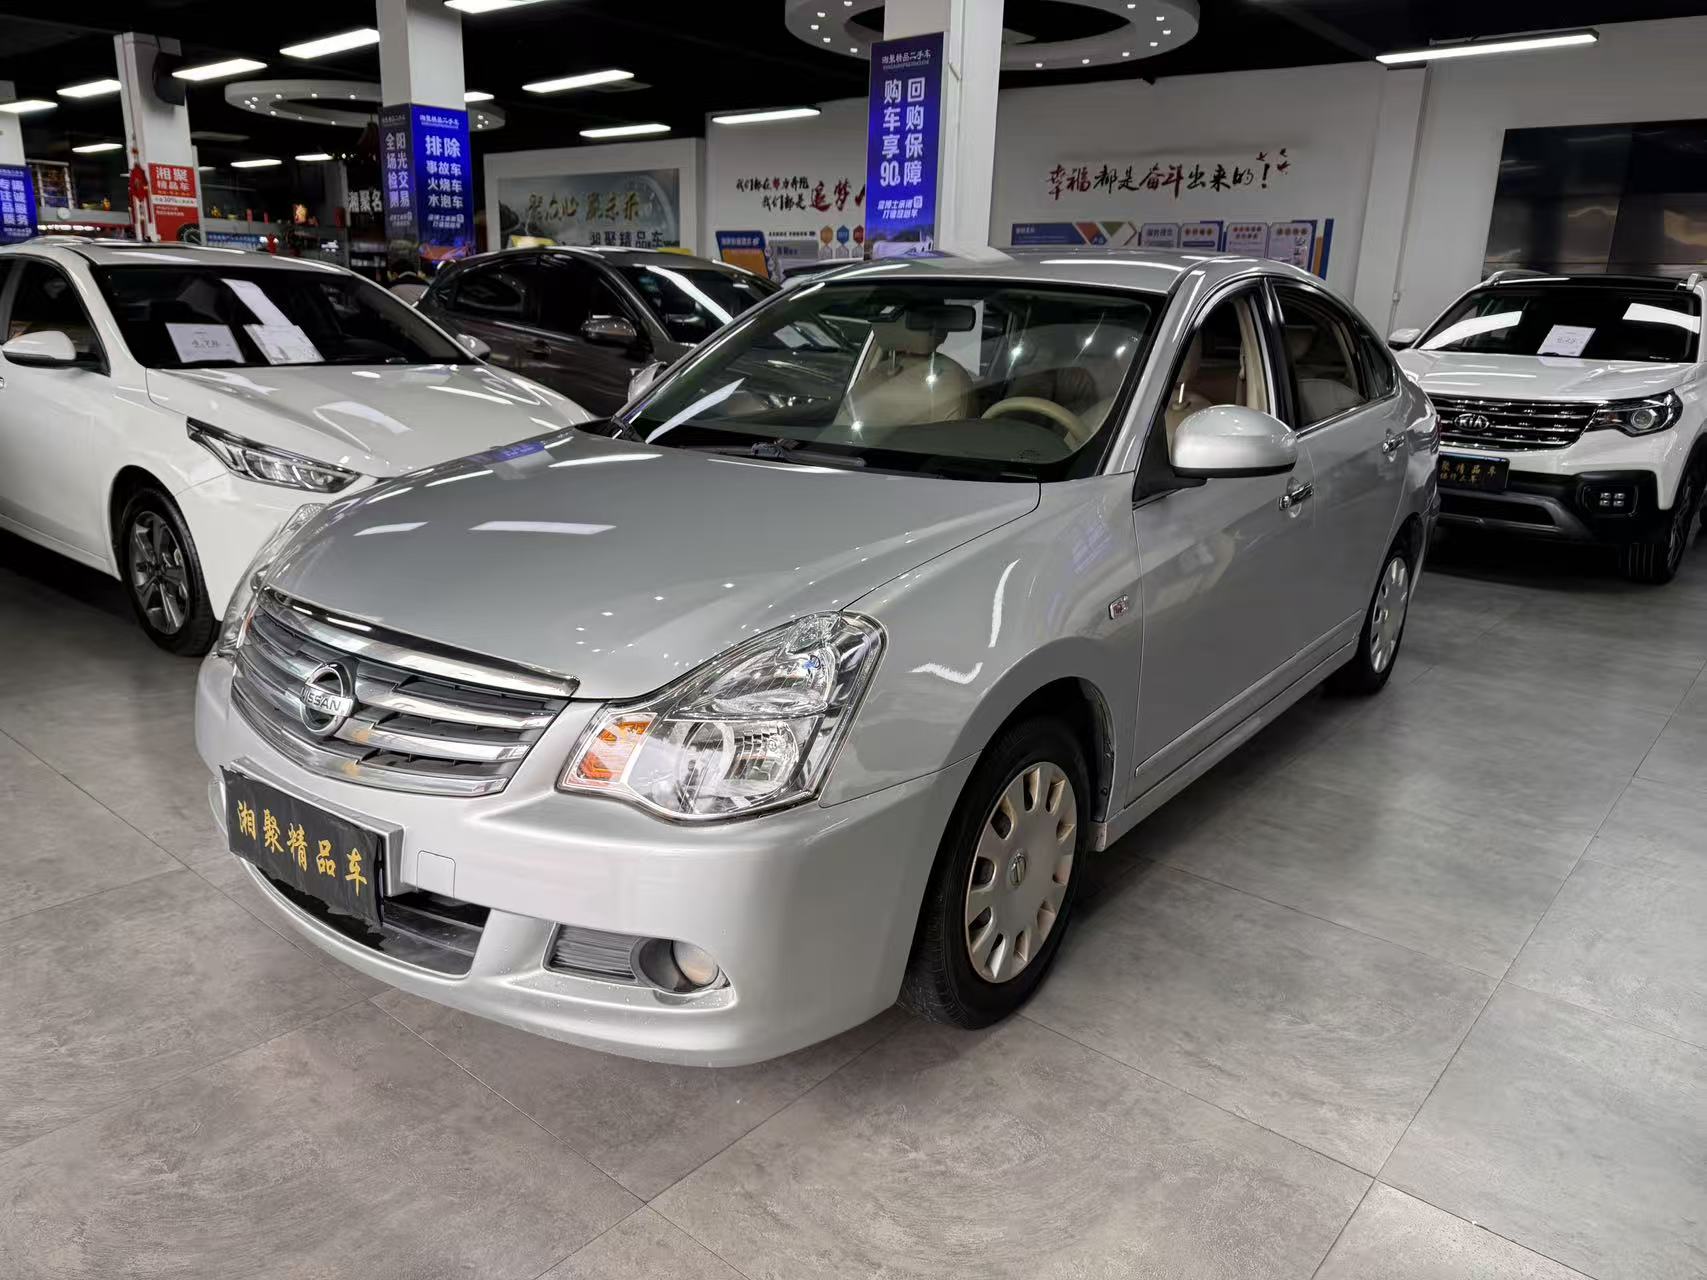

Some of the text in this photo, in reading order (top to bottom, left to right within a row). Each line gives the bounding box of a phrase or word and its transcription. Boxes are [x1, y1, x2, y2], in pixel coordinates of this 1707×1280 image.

[903, 77, 925, 187] 回购保障
[425, 135, 461, 158] 排除
[385, 133, 399, 208] 全场检测
[396, 132, 410, 208] 阳光交易
[426, 160, 462, 176] 事故车
[427, 177, 462, 193] 火烧车
[428, 193, 463, 208] 水泡车
[1459, 416, 1483, 429] KIA
[237, 800, 368, 896] 湘聚精品车
